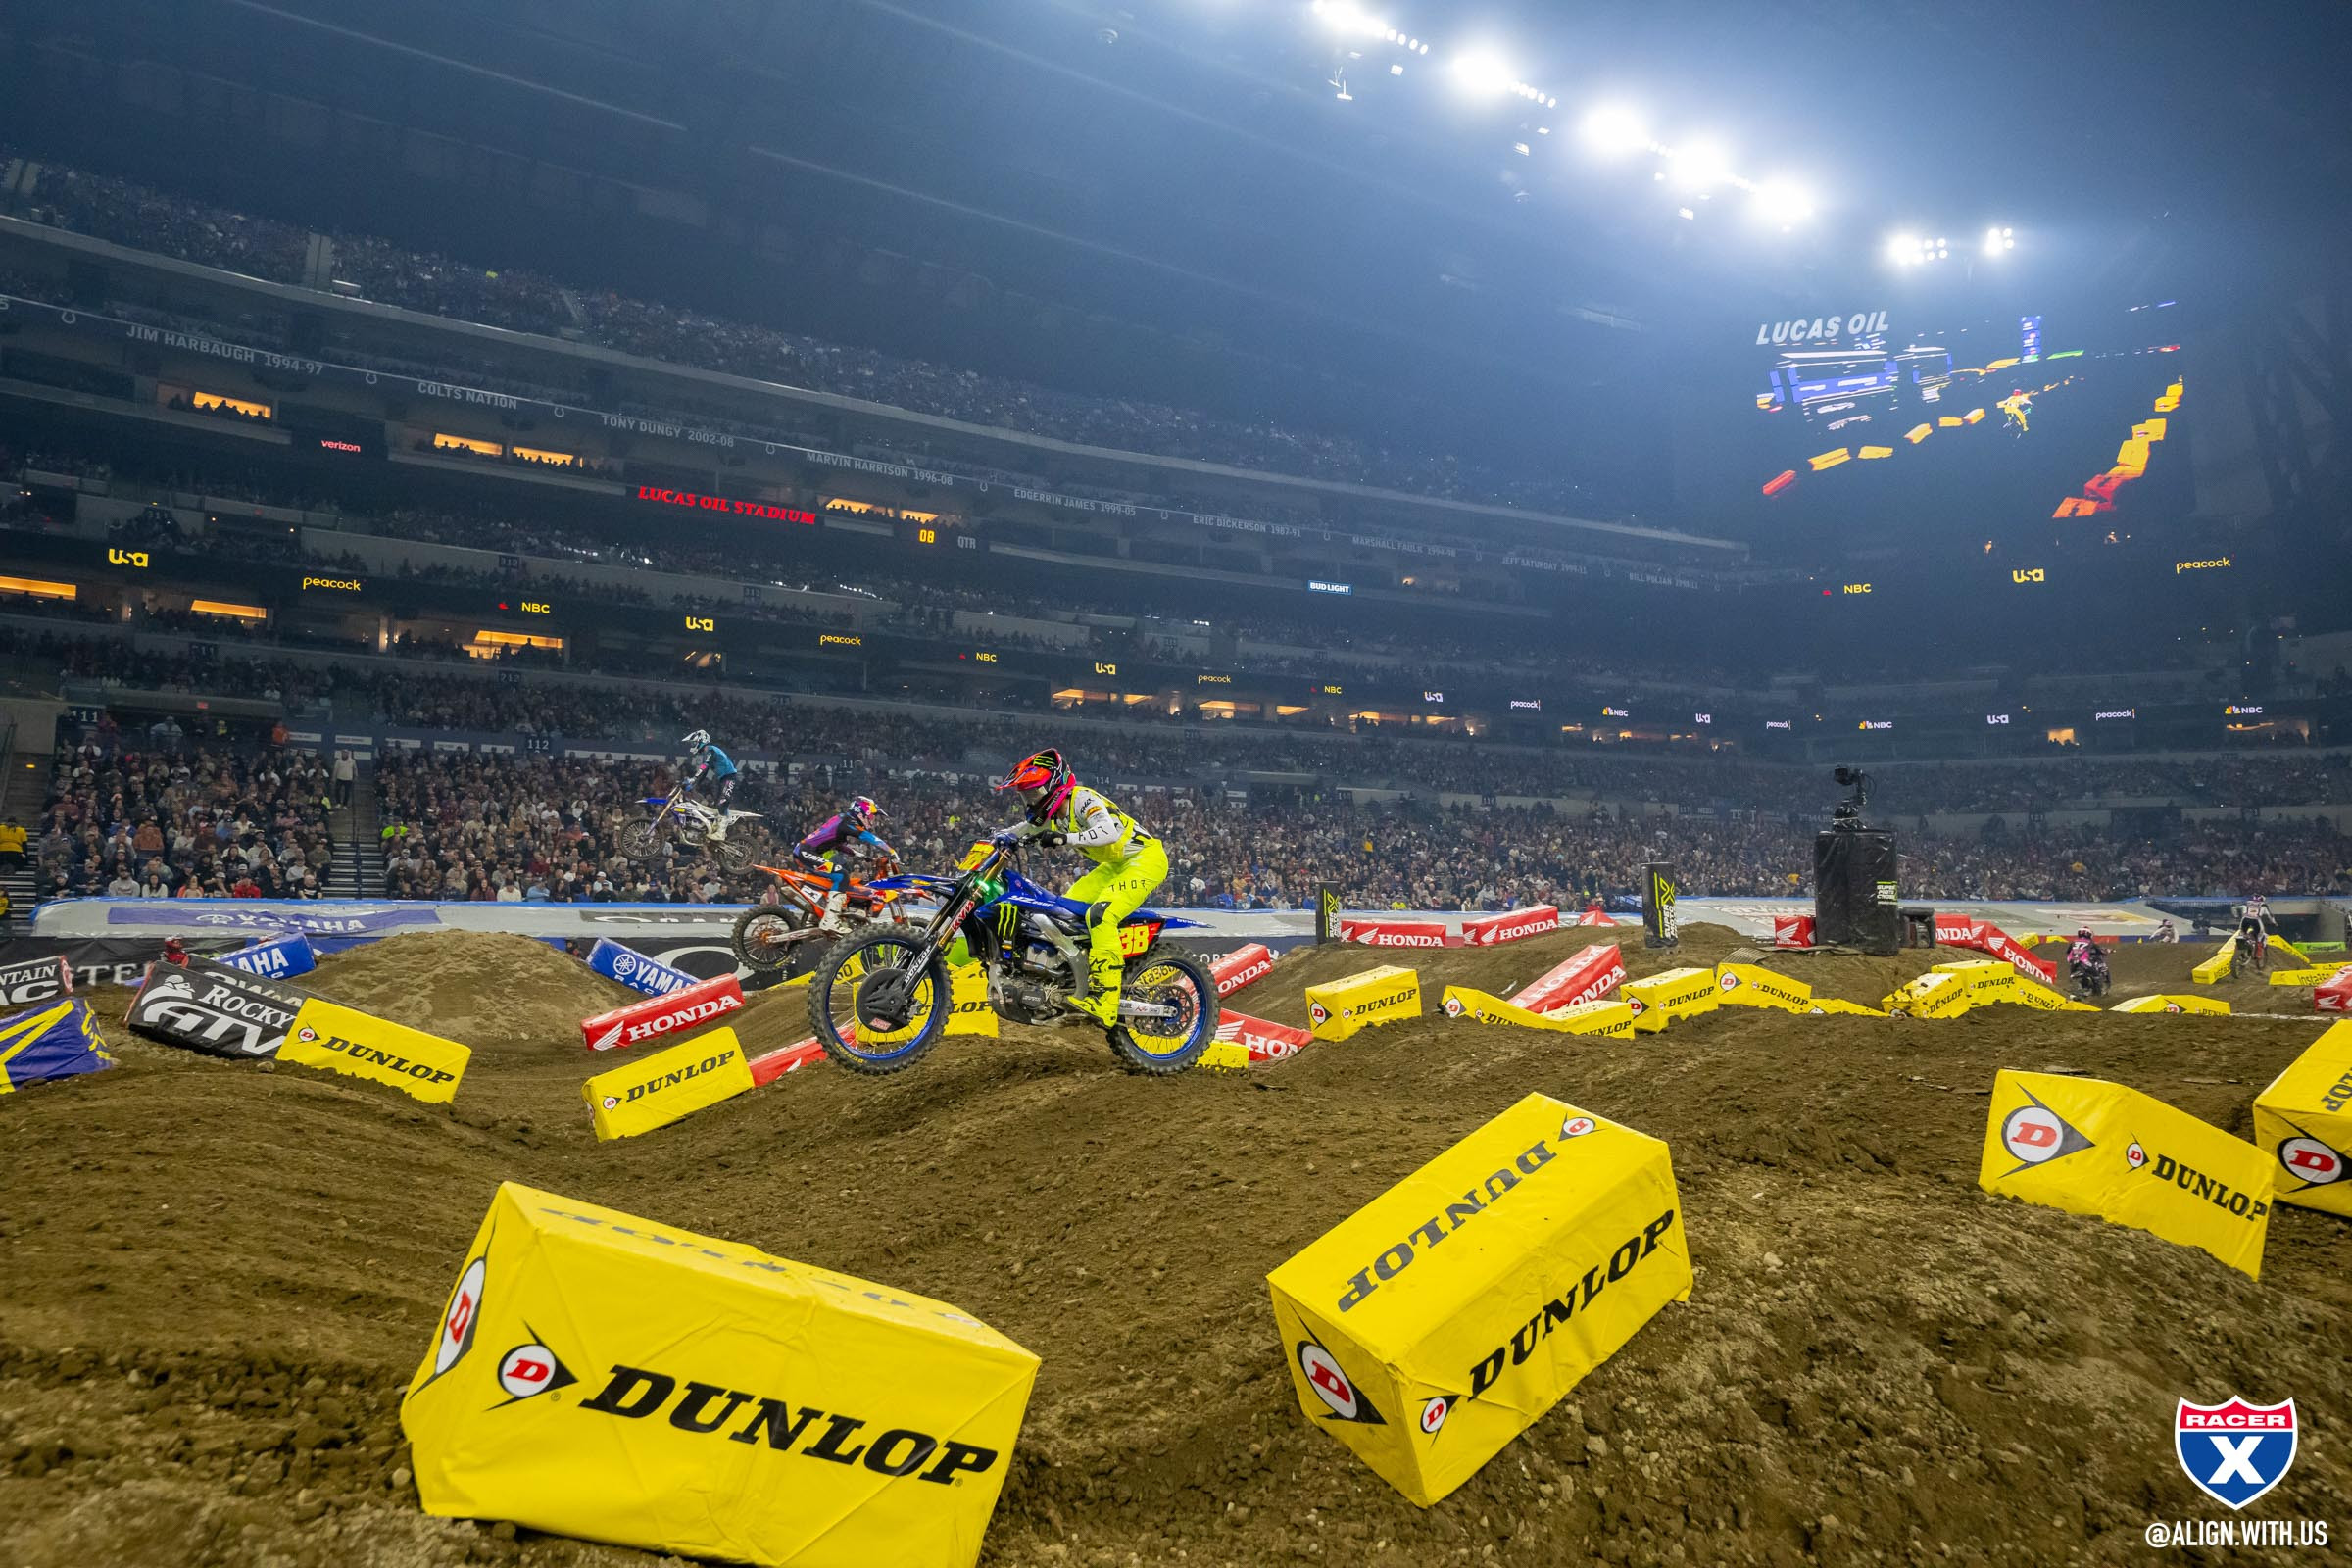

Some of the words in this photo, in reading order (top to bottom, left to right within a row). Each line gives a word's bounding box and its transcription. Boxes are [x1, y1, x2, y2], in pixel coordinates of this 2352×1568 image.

[1756, 316, 1842, 345] LUCAS
[1847, 311, 1889, 333] OIL
[126, 325, 158, 342] JIM
[164, 333, 255, 363] HARBAUGH
[264, 354, 323, 376] 1994-97
[417, 382, 463, 400] COLTS
[466, 390, 517, 410] NATION
[602, 415, 636, 429] TONY
[639, 421, 681, 438] DUNGY
[688, 429, 734, 447] 2002-08
[321, 439, 361, 453] verizon
[807, 451, 852, 467] MARVIN
[854, 460, 908, 478] HARRISON
[913, 468, 954, 486] 1996-08
[638, 485, 697, 507] LUCAS
[700, 496, 730, 512] OIL
[734, 501, 816, 524] STADIUM
[1014, 488, 1062, 506] EDGERRIN
[1063, 496, 1096, 511] JAMES
[1193, 514, 1214, 526] ERIC
[1216, 516, 1266, 534] DICKERSON
[957, 535, 977, 549] QTR
[2176, 556, 2231, 575] peacock
[303, 576, 362, 592] peacock
[1327, 584, 1349, 593] LIGHT
[1843, 583, 1873, 595] NBC
[521, 601, 551, 613] NBC
[819, 634, 862, 646] peacock
[975, 652, 998, 662] NBC
[1198, 673, 1232, 684] peacock
[1324, 685, 1343, 695] NBC
[1510, 700, 1539, 710] peacock
[1614, 709, 1629, 717] NBC
[2095, 709, 2132, 721] peacock
[2240, 706, 2264, 714] NBC
[1766, 720, 1789, 730] peacock
[527, 739, 549, 750] 112
[1120, 925, 1150, 956] 38
[1378, 933, 1444, 947] HONDA
[1498, 919, 1558, 940] HONDA
[2003, 945, 2054, 984] HONDA
[1217, 959, 1272, 994] ONDA
[1568, 964, 1627, 1005] ONDA
[1977, 976, 2015, 990] DUNLOP
[198, 984, 297, 1029] ROCKY
[1354, 989, 1417, 1016] DUNLOP
[1668, 985, 1716, 1008] DUNLOP
[1760, 984, 1809, 1006] DUNLOP
[1930, 987, 1964, 1014] DUNLOP
[144, 1001, 288, 1054] ATV
[626, 994, 742, 1041] HONDA
[320, 1036, 456, 1085] DUNLOP
[625, 1050, 735, 1102] DUNLOP
[2152, 1153, 2269, 1222] DUNLOP
[1338, 1139, 1558, 1314] DUNLOP
[1467, 1209, 1675, 1403] DUNLOP
[578, 1364, 999, 1486] DUNLOP
